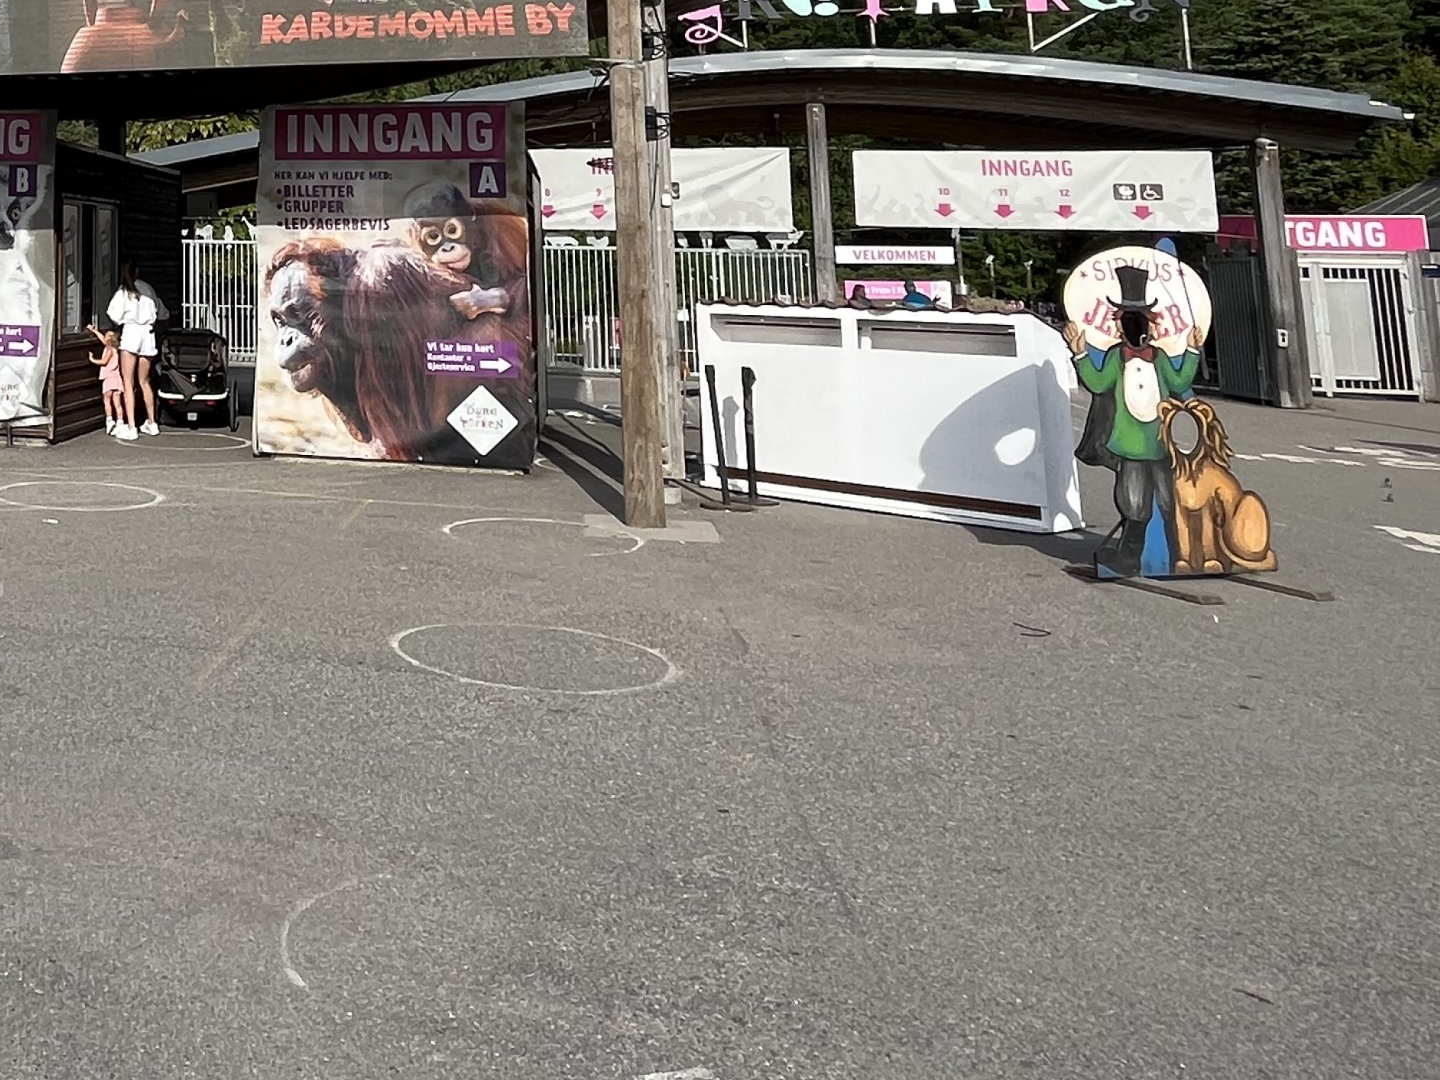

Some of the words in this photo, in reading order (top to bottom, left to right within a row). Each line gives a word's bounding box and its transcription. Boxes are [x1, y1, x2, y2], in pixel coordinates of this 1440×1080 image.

[260, 4, 515, 44] KARDEMOMME
[525, 1, 575, 37] BY
[287, 111, 494, 154] INNGANG
[16, 167, 29, 193] B
[274, 170, 292, 180] HER
[296, 170, 315, 180] KAN
[319, 170, 328, 180] VI
[332, 170, 365, 180] HJELPE
[369, 170, 393, 180] MED:
[477, 166, 499, 193] A
[980, 159, 1073, 177] INNGANG
[595, 187, 602, 197] 9
[938, 187, 950, 196] 10
[998, 188, 1008, 197] 11
[1059, 188, 1071, 197] 12
[1284, 220, 1387, 248] TGANG
[852, 249, 936, 261] VELKOMMEN
[1082, 297, 1190, 341] JEER
